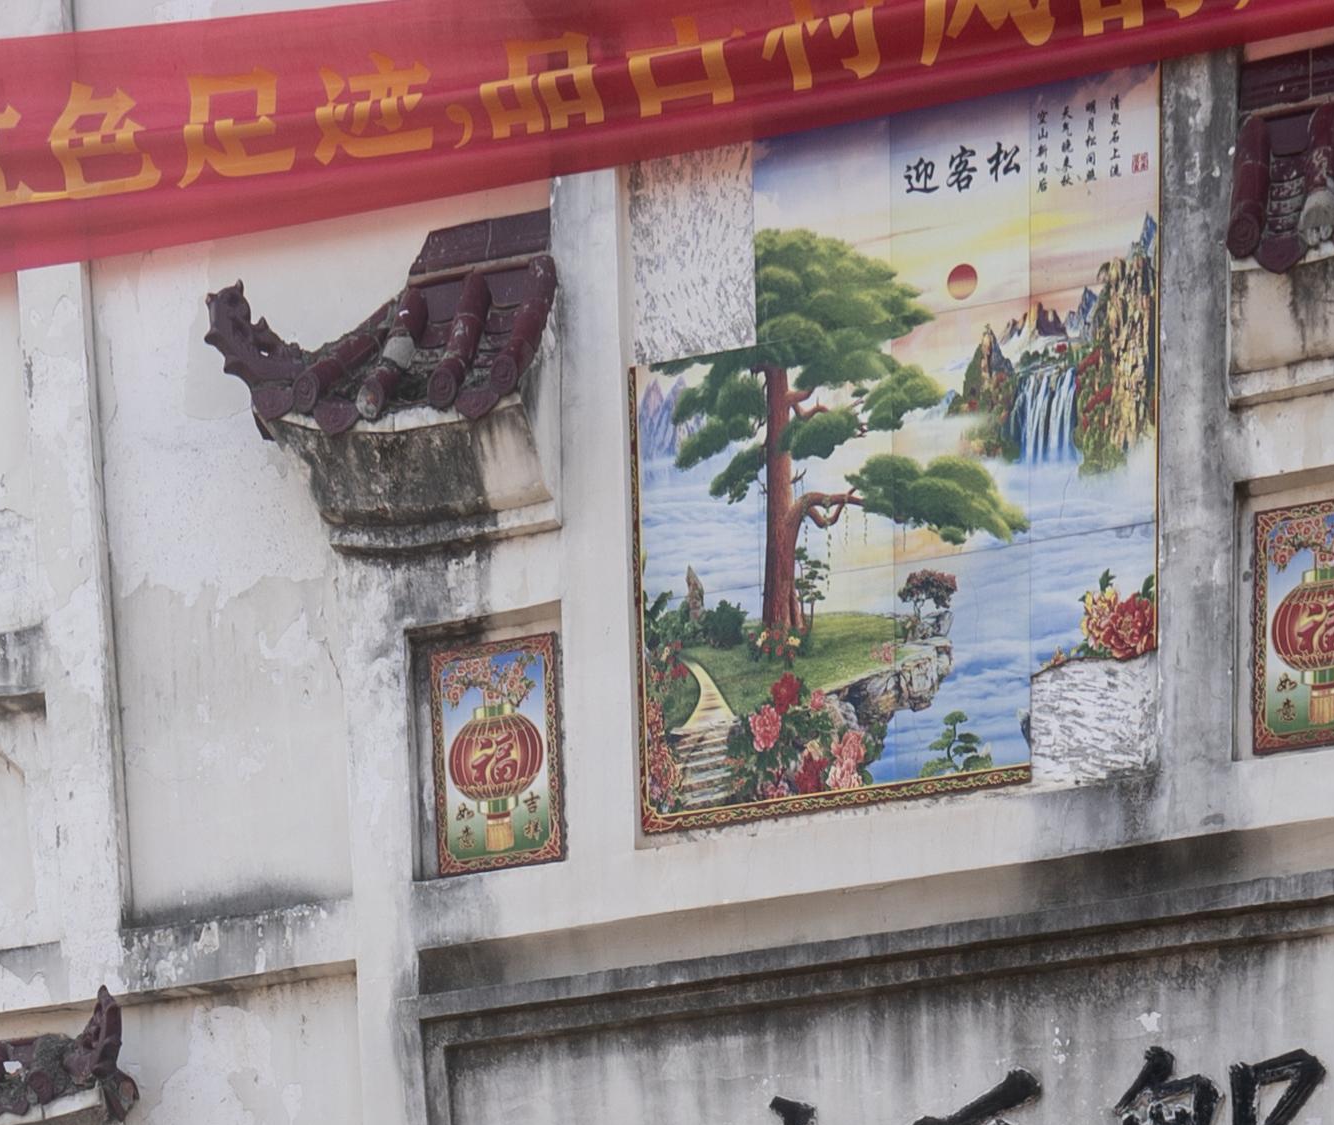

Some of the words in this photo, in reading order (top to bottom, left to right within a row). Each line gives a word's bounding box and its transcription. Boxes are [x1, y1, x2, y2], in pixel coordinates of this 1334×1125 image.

[903, 142, 1022, 194] 迎客松
[470, 731, 519, 786] 福
